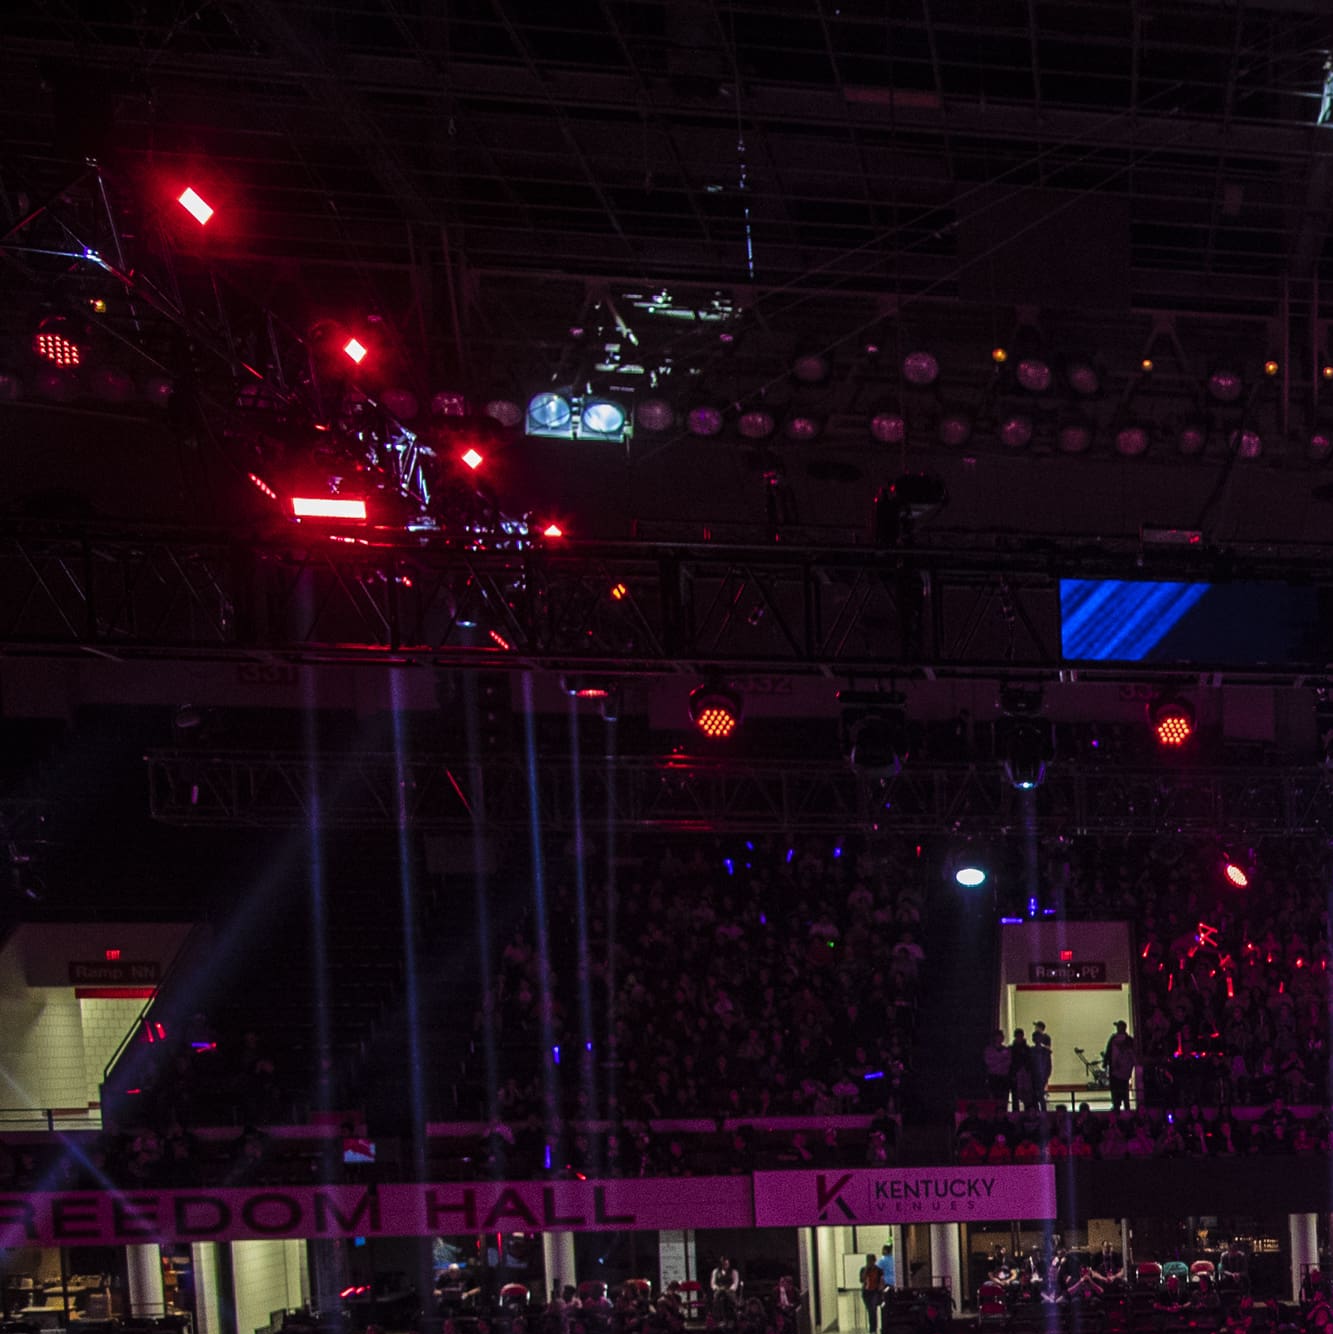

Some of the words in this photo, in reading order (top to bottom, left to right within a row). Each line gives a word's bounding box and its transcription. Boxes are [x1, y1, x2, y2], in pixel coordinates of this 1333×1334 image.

[875, 1178, 995, 1200] KENTUCKY
[425, 1186, 636, 1230] HALL
[876, 1200, 975, 1212] VENUES
